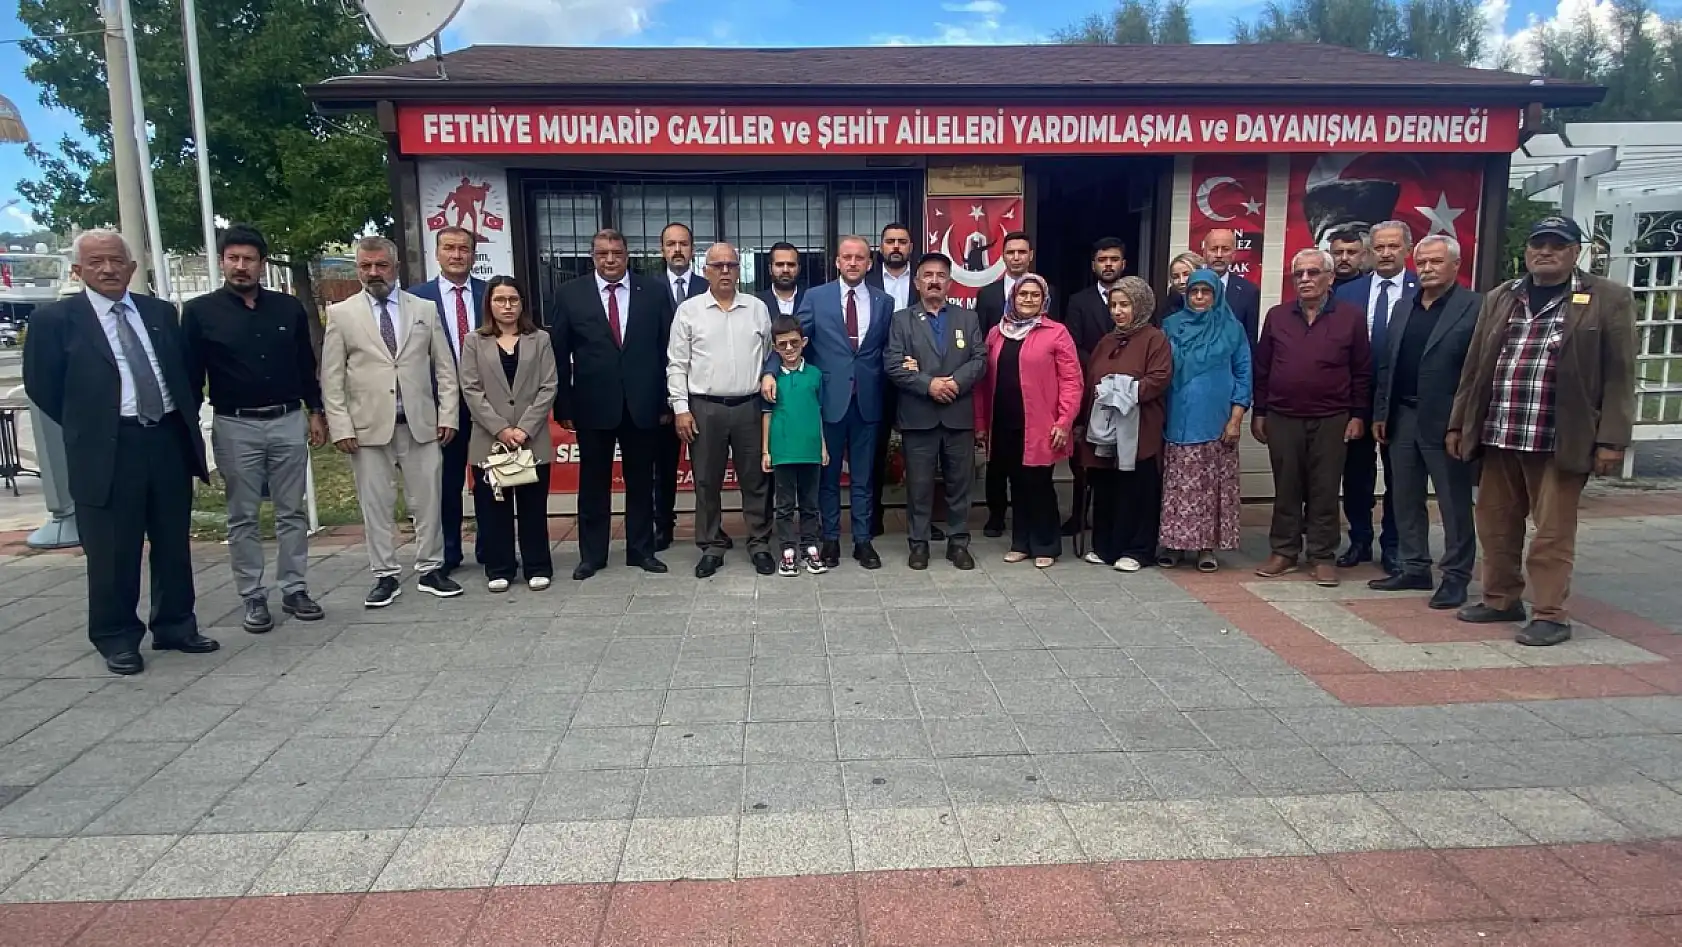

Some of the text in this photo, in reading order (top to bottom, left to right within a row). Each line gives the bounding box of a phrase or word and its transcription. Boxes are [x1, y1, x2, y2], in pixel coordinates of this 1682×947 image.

[423, 106, 1488, 150] FETHİYE MUHARİP GAZİLER ve ŞEHİT AİLELERİ YARDIMLAŞMA ve DAYANIŞMA DERNEĞİ
